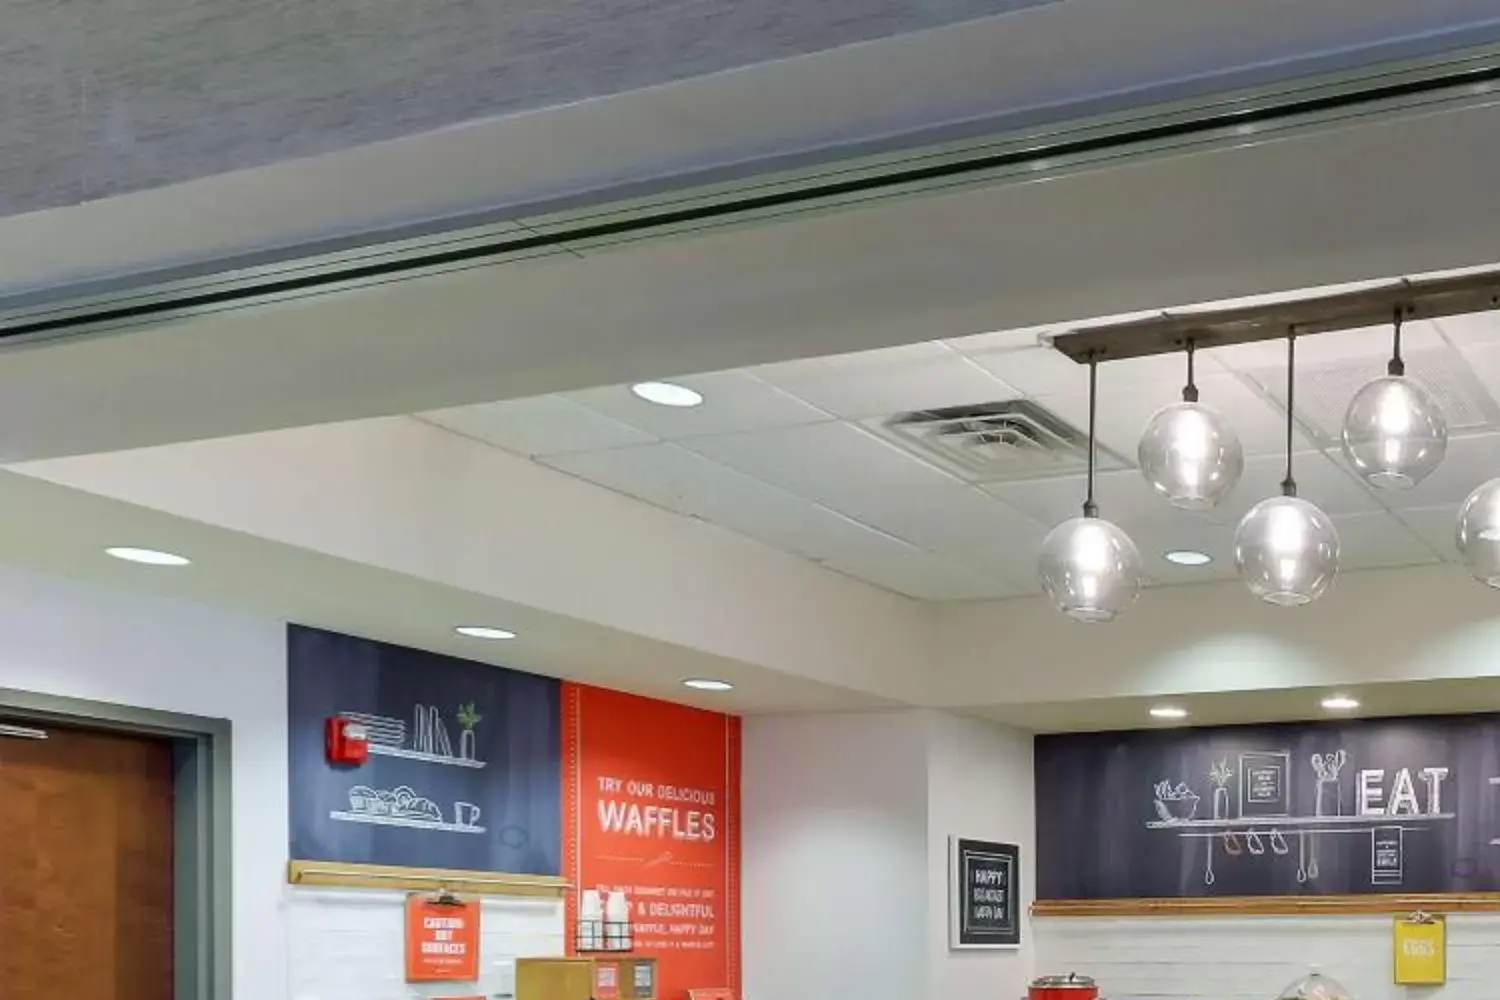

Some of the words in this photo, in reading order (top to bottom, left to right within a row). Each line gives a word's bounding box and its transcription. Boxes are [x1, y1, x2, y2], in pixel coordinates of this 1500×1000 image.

[598, 776, 622, 792] TRY
[627, 781, 655, 797] OUR
[657, 785, 716, 805] DELICIOUS
[1356, 768, 1449, 816] EAT
[598, 799, 715, 841] WAFFLES
[649, 902, 714, 918] DELIGHTFUL
